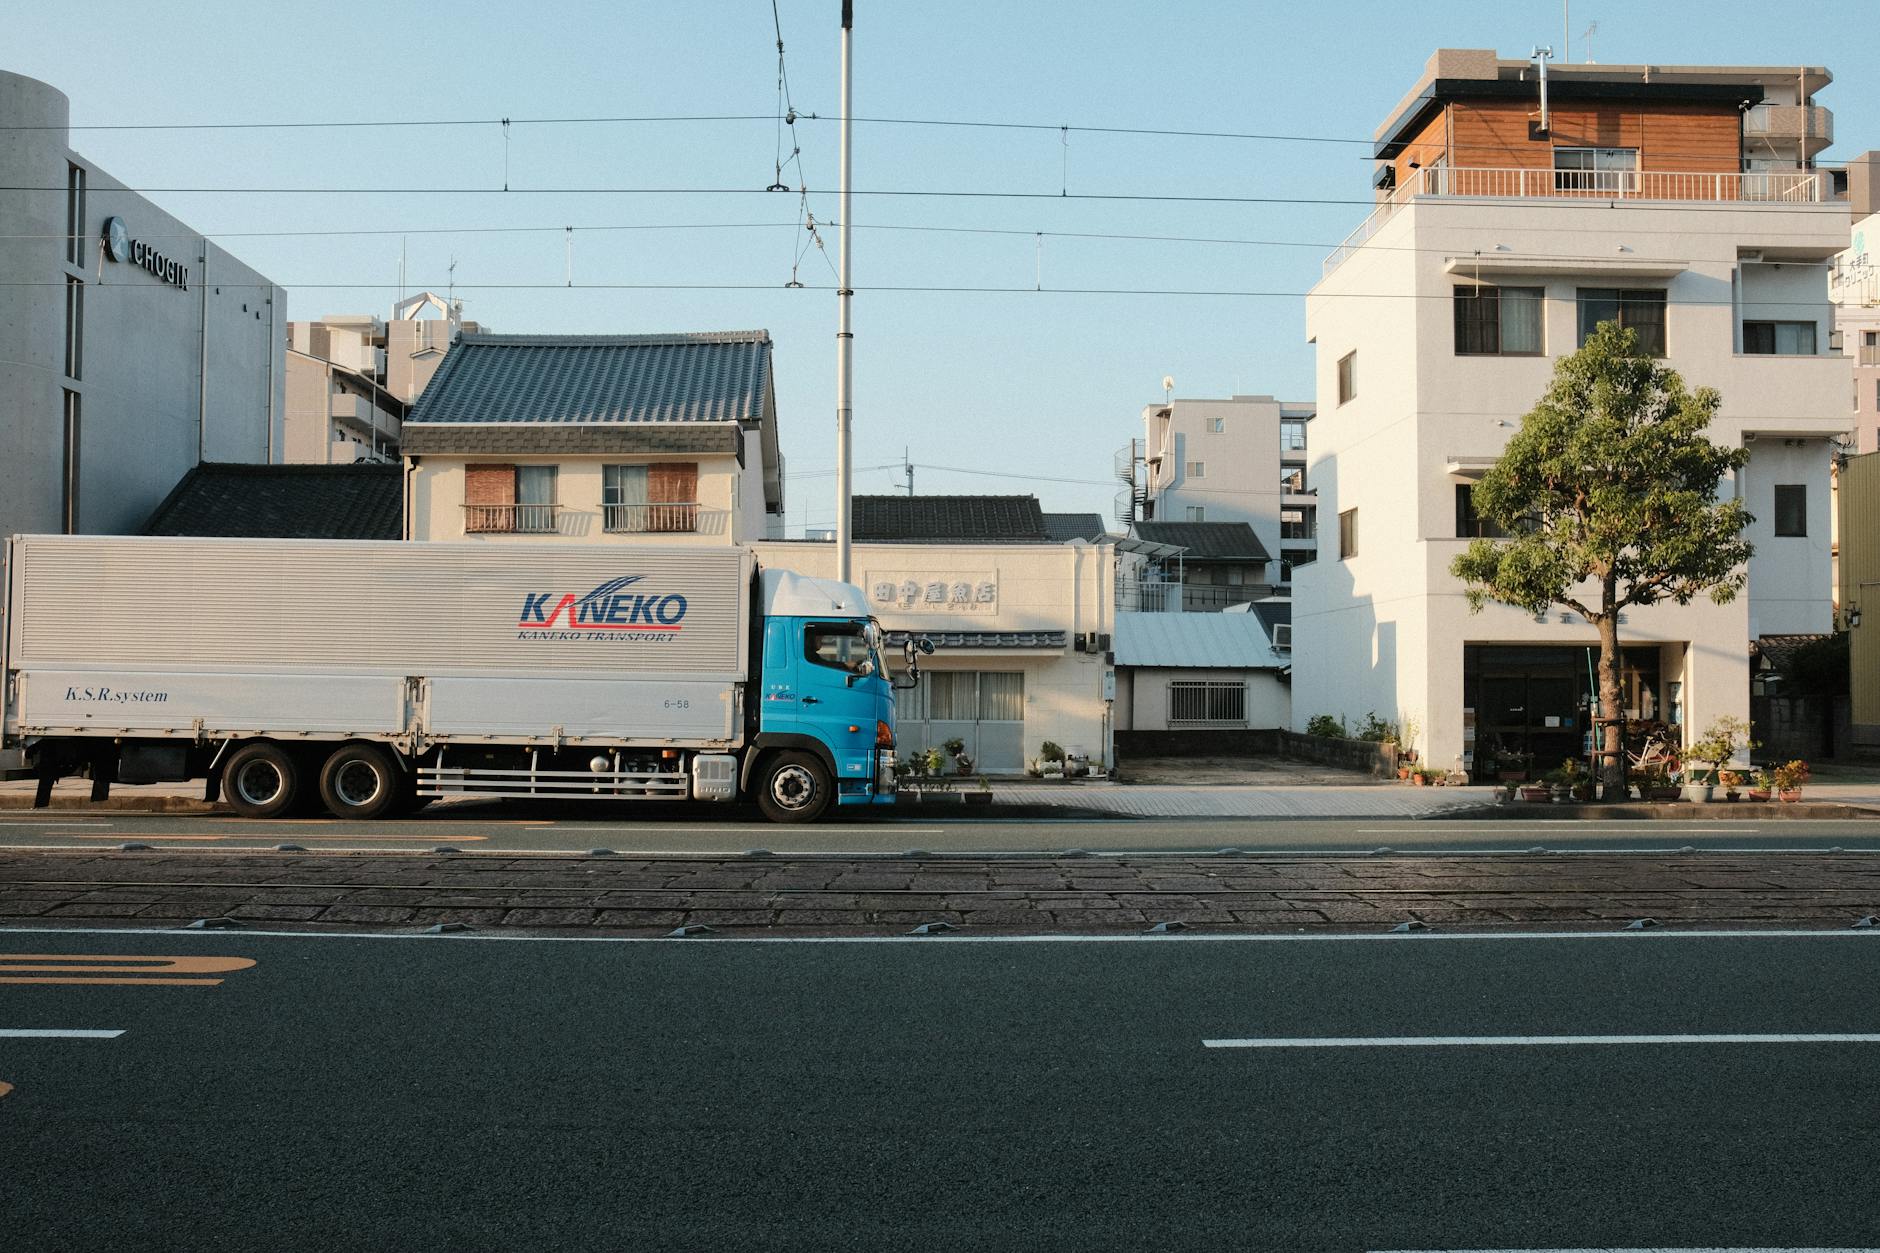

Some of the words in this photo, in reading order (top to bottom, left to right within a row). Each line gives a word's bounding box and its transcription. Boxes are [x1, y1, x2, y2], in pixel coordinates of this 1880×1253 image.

[133, 240, 189, 291] CHOGIN
[519, 593, 688, 628] KANEKO
[517, 631, 581, 641] KANEKO
[586, 632, 678, 642] TRANSPORT
[65, 687, 168, 703] K.S.R.system
[664, 699, 689, 709] 6-58
